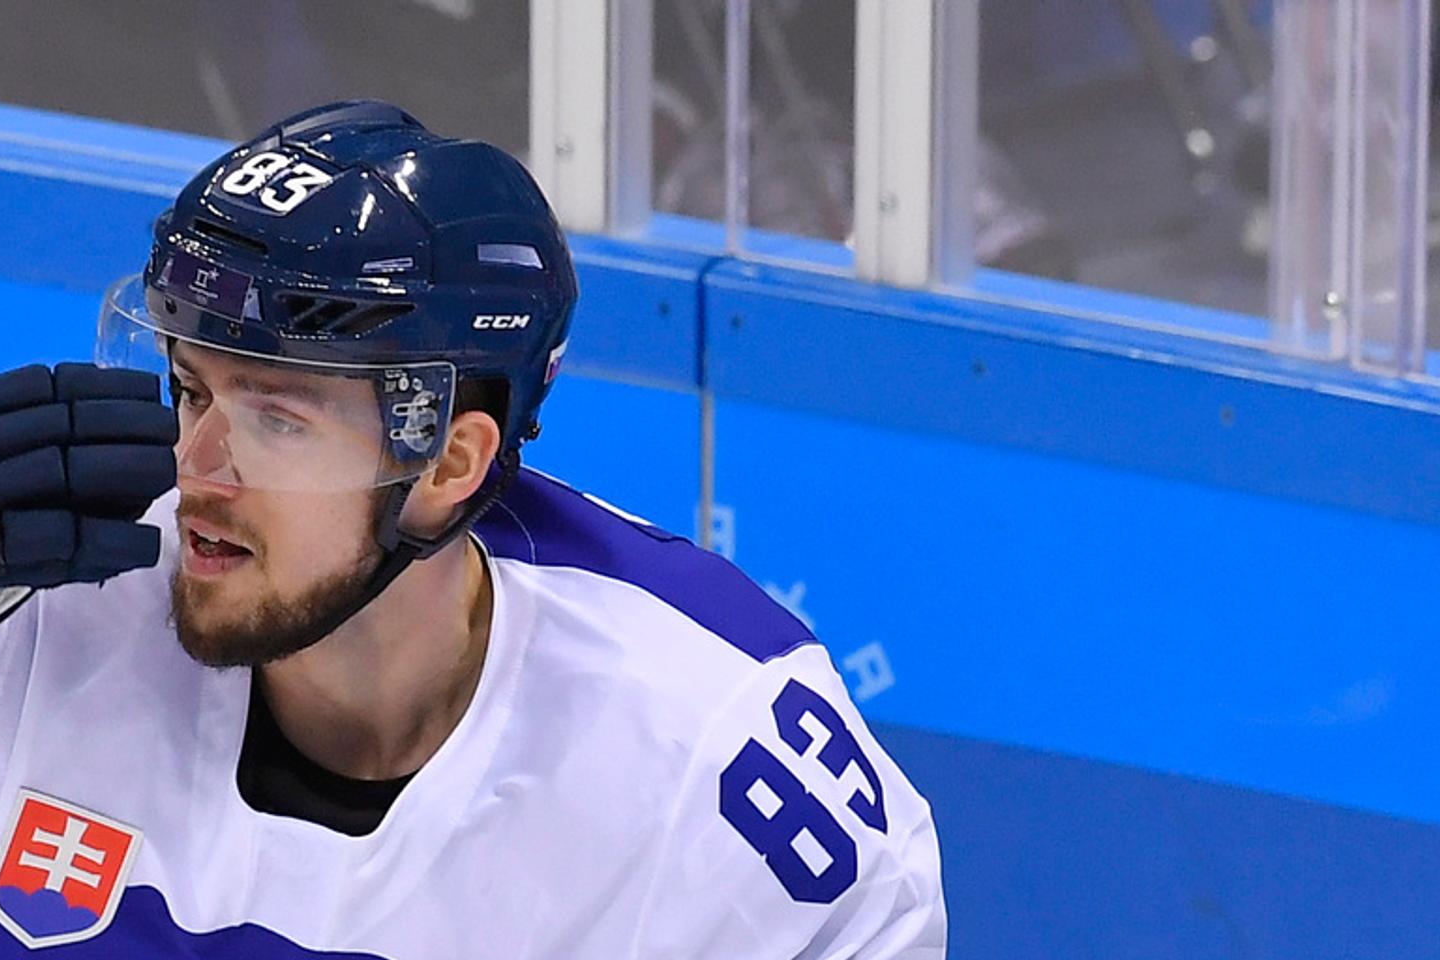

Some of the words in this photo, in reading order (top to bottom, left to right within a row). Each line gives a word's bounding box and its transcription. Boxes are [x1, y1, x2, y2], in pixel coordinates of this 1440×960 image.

[222, 151, 333, 213] 83
[473, 314, 531, 330] CCM
[720, 678, 888, 905] 83
